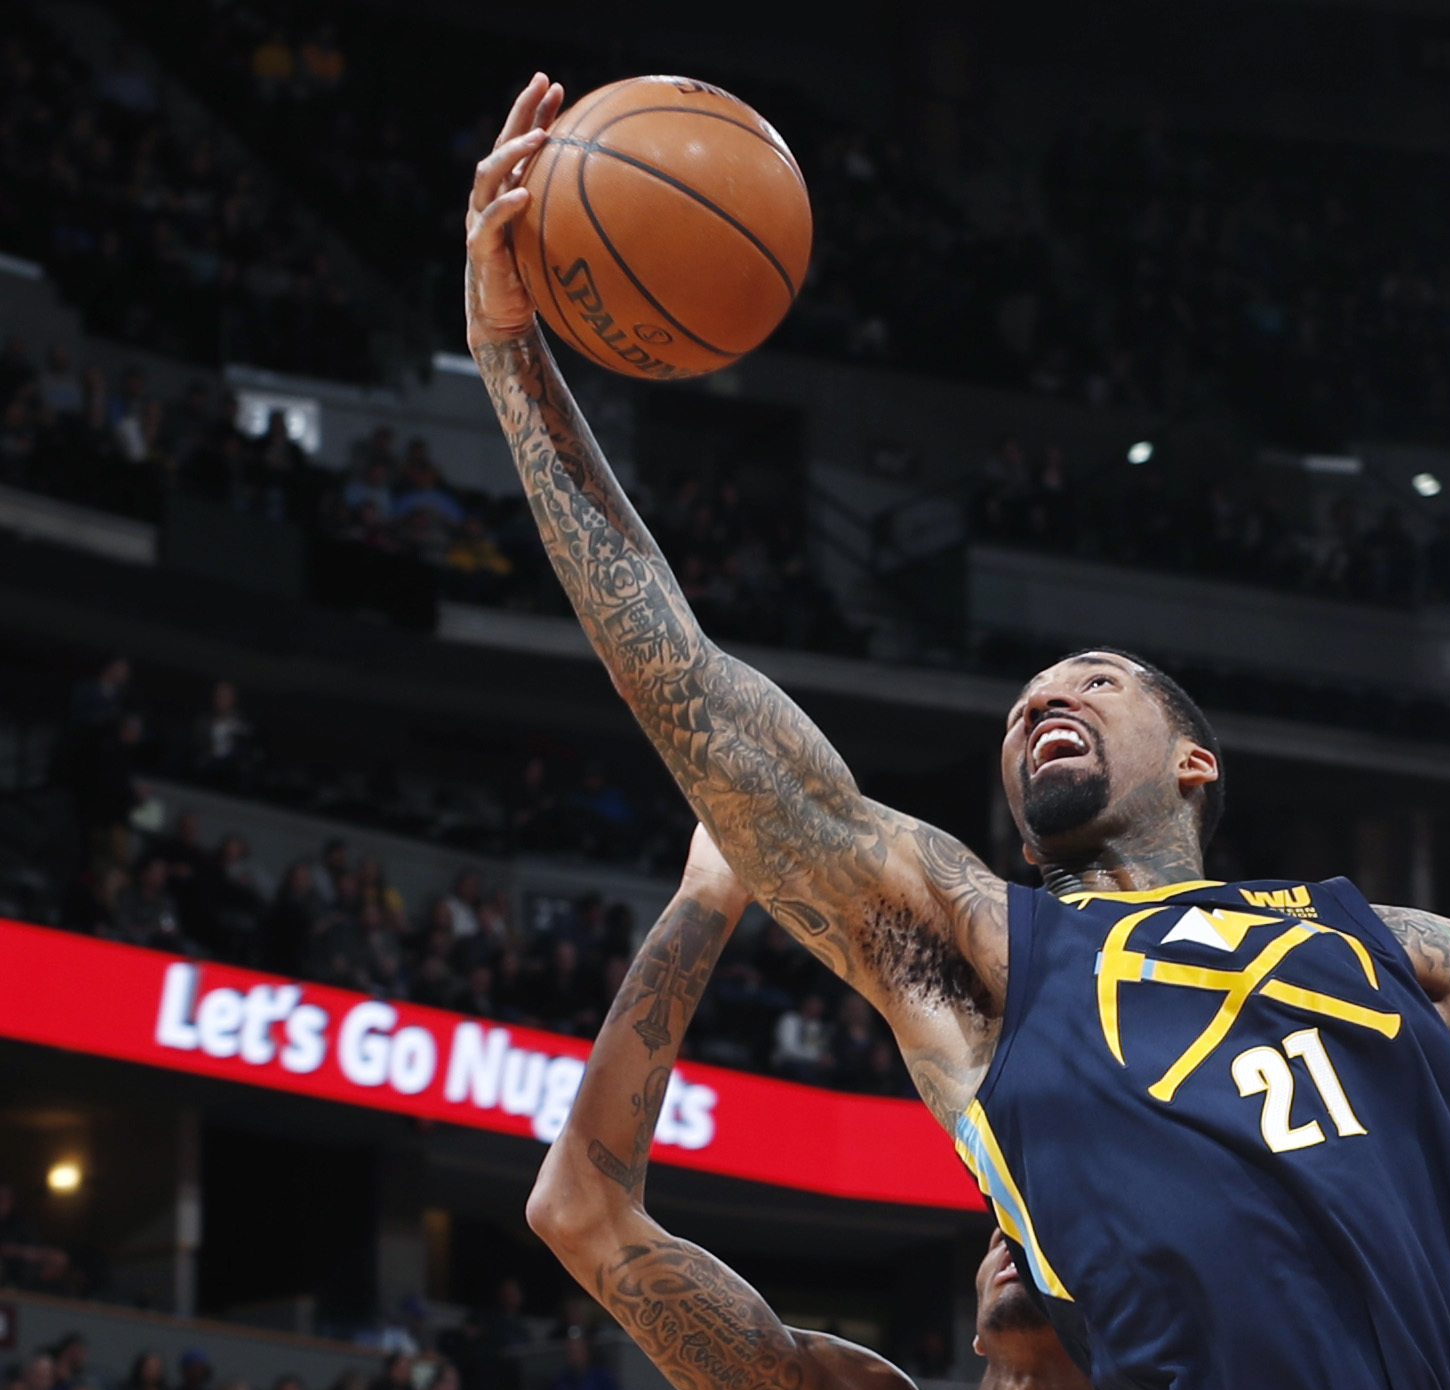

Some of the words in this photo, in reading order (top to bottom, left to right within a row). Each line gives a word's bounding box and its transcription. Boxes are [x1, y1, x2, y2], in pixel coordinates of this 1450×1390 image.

[1239, 885, 1311, 908] WU
[156, 962, 329, 1073] Let's
[337, 1001, 437, 1096] Go
[445, 1021, 718, 1149] Nugts
[1231, 1027, 1367, 1153] 21
